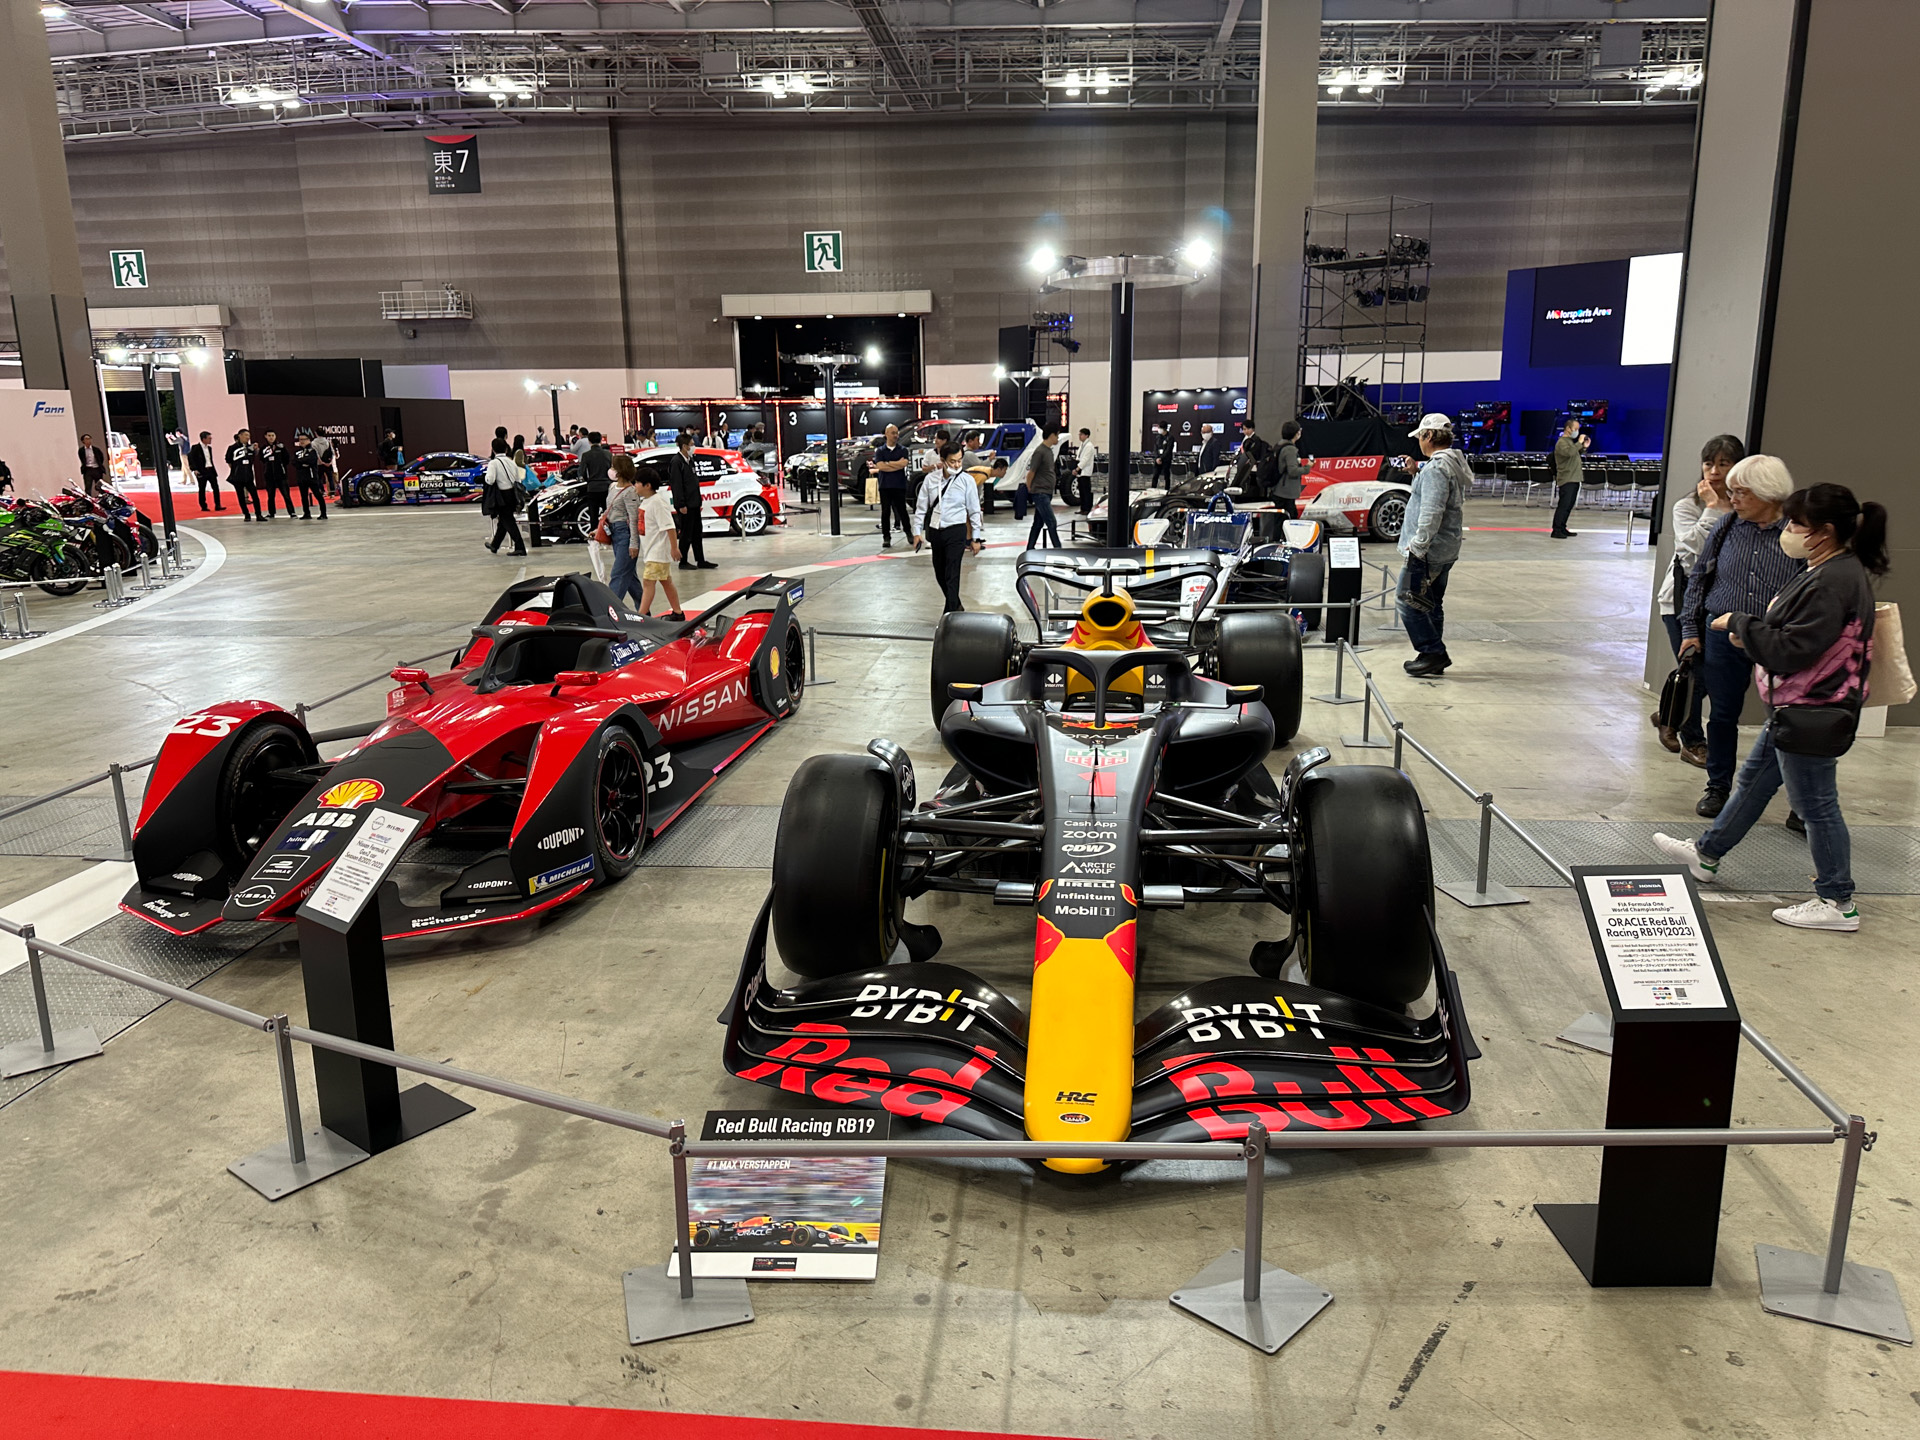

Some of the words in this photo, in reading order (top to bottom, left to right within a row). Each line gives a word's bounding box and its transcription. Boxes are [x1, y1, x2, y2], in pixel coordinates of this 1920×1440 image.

[1546, 308, 1592, 320] Motorsports
[1592, 306, 1612, 317] Area
[649, 412, 655, 427] 1
[718, 411, 727, 426] 2
[788, 411, 798, 426] 3
[859, 410, 869, 426] 4
[1320, 460, 1331, 470] HY
[1334, 457, 1377, 470] DENSO
[407, 480, 417, 488] 61
[1339, 496, 1363, 506] FUJITSU
[631, 690, 671, 701] Ariya
[657, 676, 749, 733] NISSAN
[170, 712, 242, 738] 23
[643, 751, 674, 795] 23
[291, 811, 357, 829] ABB
[1064, 820, 1091, 828] Cash
[1094, 820, 1118, 828] App
[541, 827, 580, 850] DUPONT
[1080, 861, 1117, 869] ARCTIC
[549, 861, 591, 883] MICHELIN
[473, 880, 509, 889] DUPONT
[1057, 878, 1117, 889] PIRELLI
[234, 892, 277, 901] NISSAN
[1056, 891, 1116, 901] infinitum
[1054, 905, 1099, 917] Mobil
[412, 913, 478, 929] Recharge
[1608, 917, 1648, 927] ORACLE
[1649, 916, 1668, 926] Red
[1669, 916, 1688, 926] Bull
[1606, 928, 1640, 939] Racing
[1640, 926, 1696, 938] RB19(2023)
[850, 984, 991, 1033] BYBIT
[1181, 995, 1326, 1044] BYBIT
[735, 1022, 999, 1125] Red
[1055, 1091, 1098, 1103] HRC
[1161, 1045, 1454, 1141] Bull
[715, 1117, 744, 1134] Red
[748, 1117, 778, 1134] Bull
[780, 1117, 833, 1137] Racing
[836, 1117, 876, 1134] RB19
[706, 1160, 718, 1170] #1
[718, 1160, 738, 1170] MAX
[738, 1159, 791, 1170] VERSTAPPEN
[737, 1228, 773, 1237] ORACLE
